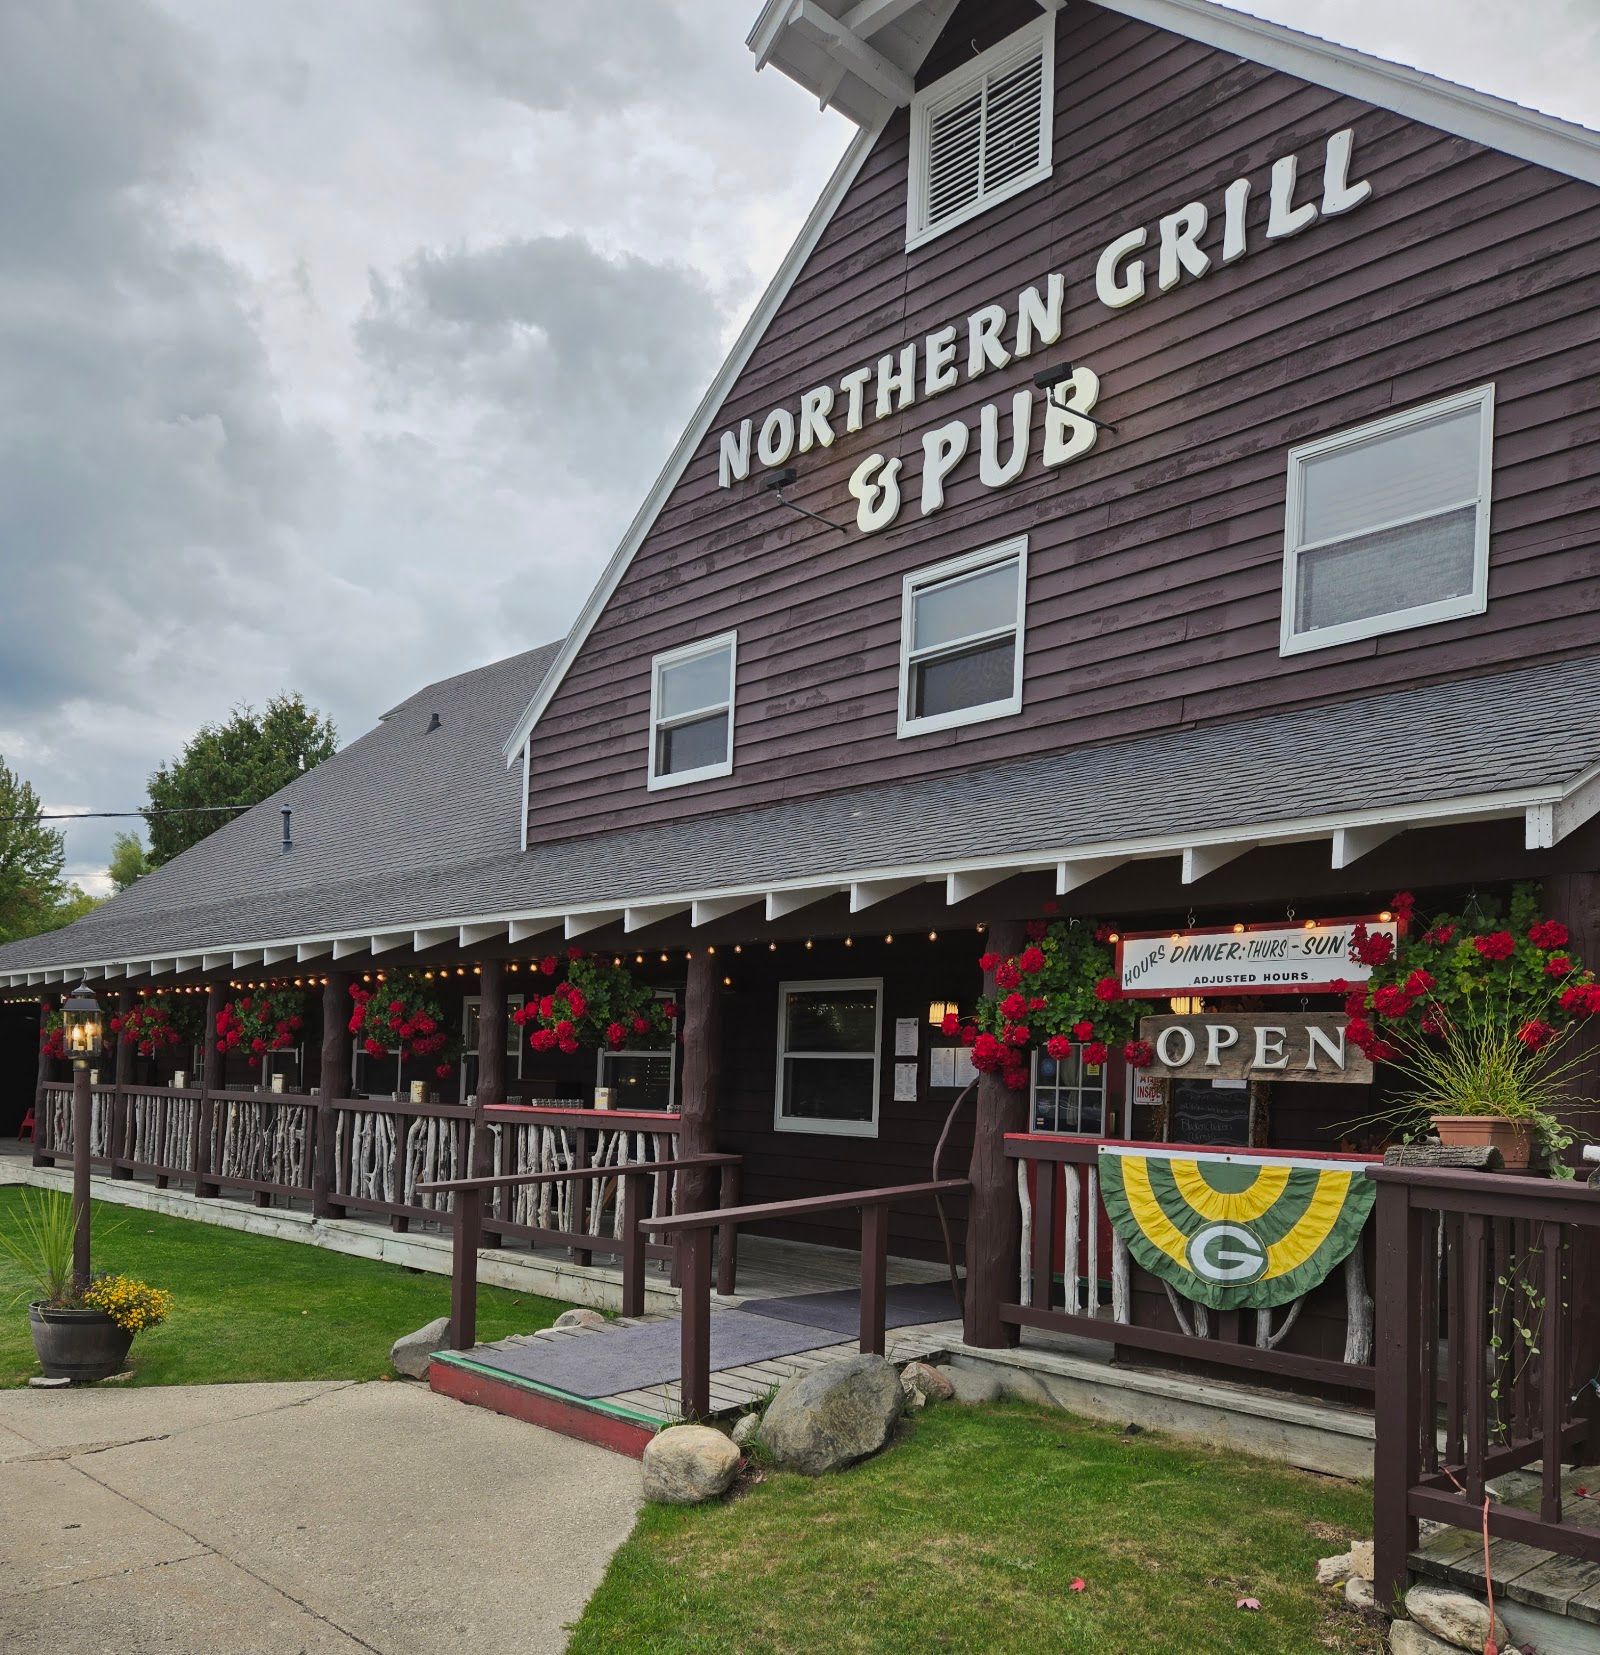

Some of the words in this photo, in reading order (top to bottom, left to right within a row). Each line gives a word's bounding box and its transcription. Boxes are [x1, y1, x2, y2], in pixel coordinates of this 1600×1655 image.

[718, 274, 1064, 488] NORTHERN
[1095, 128, 1372, 308] GRILL
[848, 453, 902, 533] &
[920, 366, 1099, 515] PUB
[1124, 944, 1166, 986] HOURS
[1170, 941, 1245, 963] DINNER:
[1247, 938, 1288, 958] THURS
[1193, 974, 1256, 985] ADJUSTED
[1263, 972, 1309, 982] HOURS
[1156, 1024, 1346, 1070] OPEN
[1190, 1225, 1264, 1280] G
